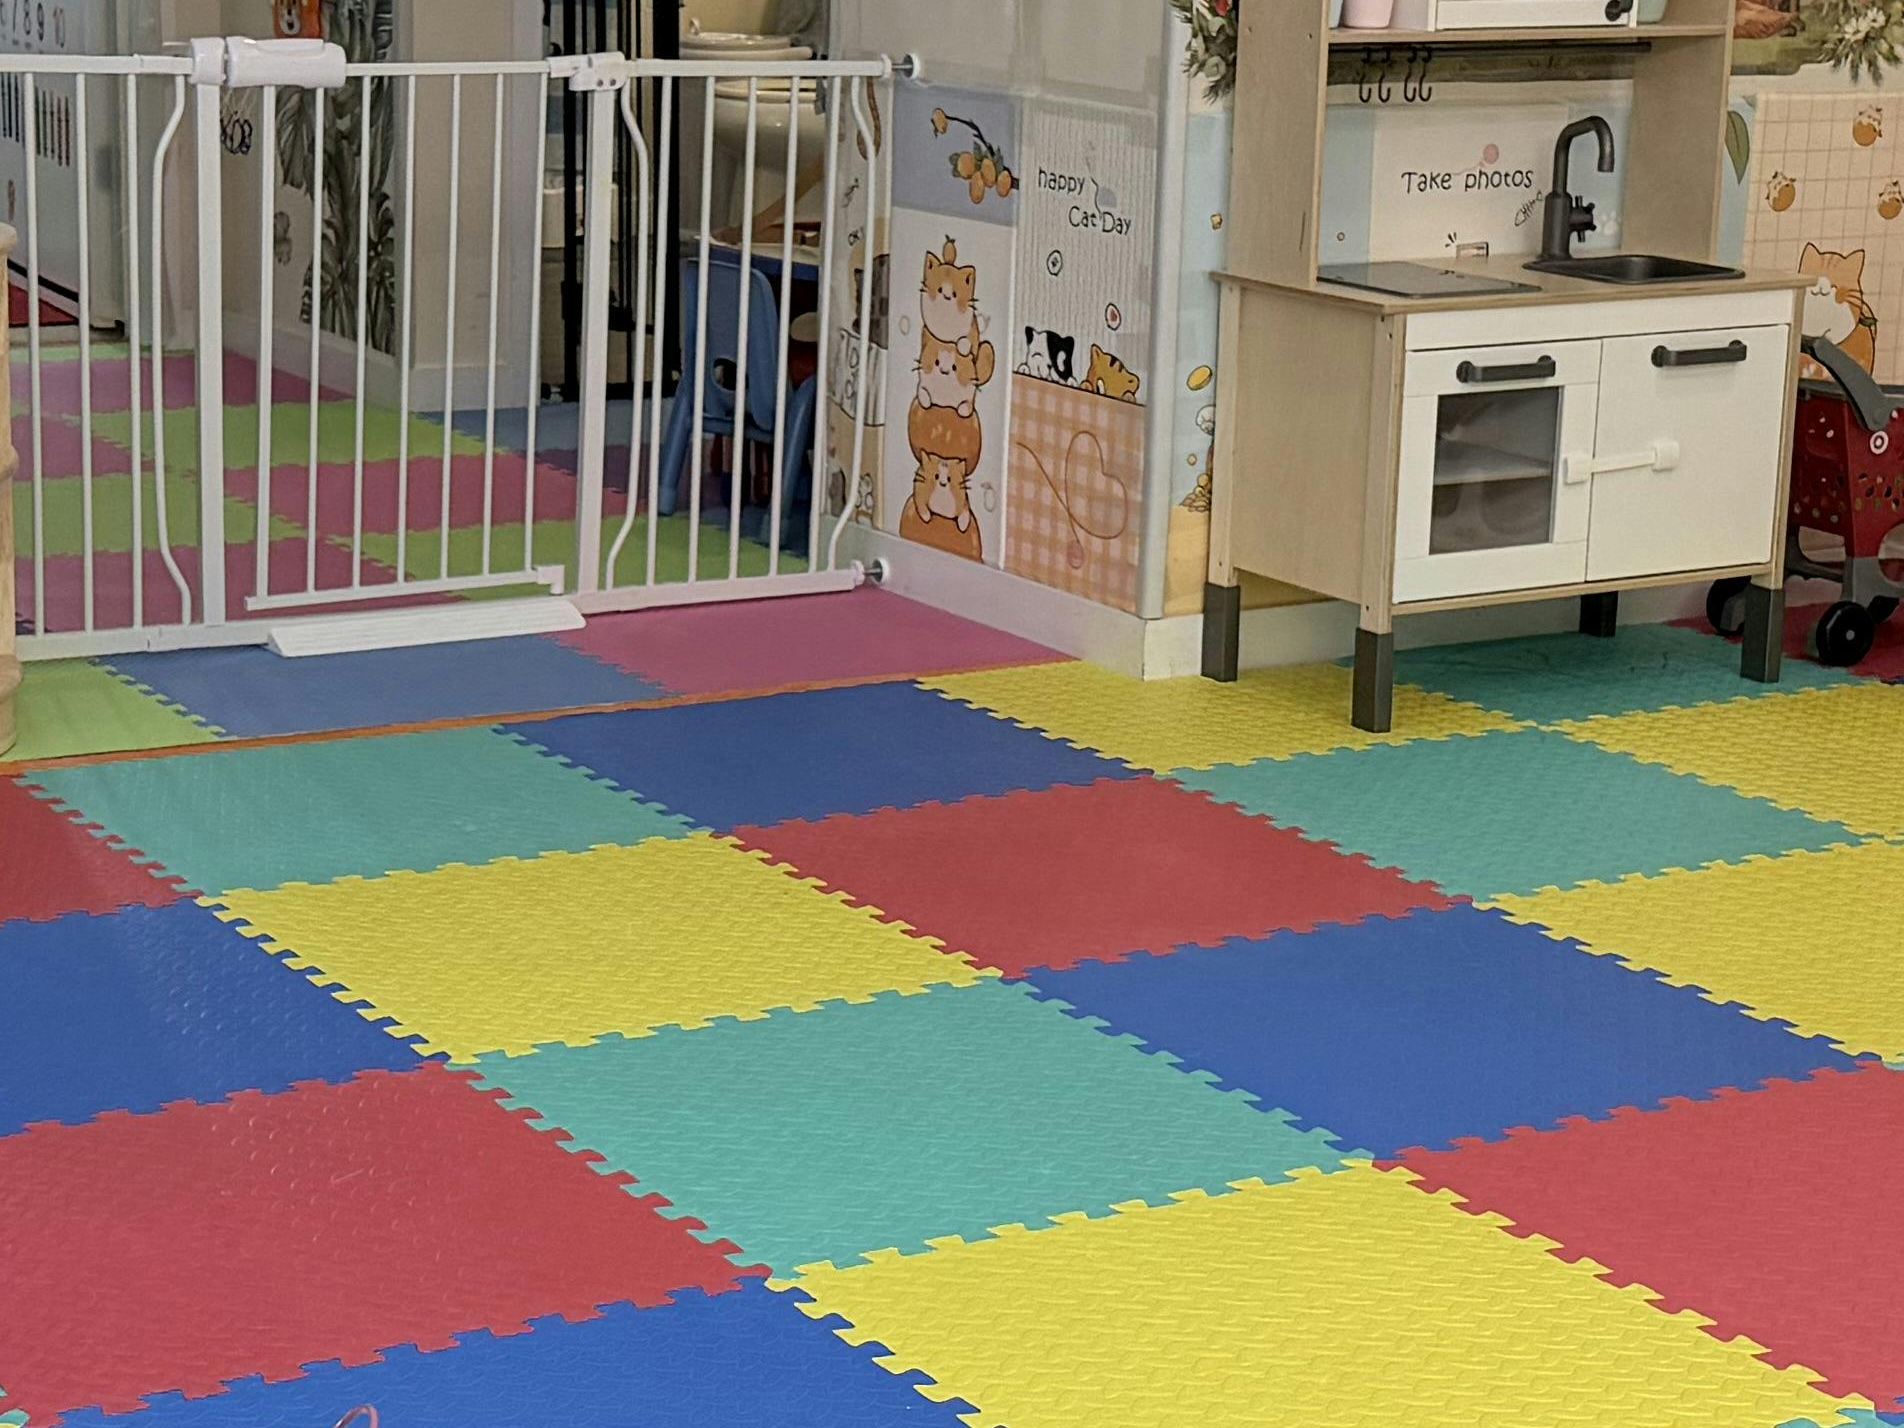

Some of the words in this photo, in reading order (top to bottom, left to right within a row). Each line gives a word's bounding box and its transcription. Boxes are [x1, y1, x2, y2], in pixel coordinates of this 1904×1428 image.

[1401, 171, 1452, 194] Take
[1464, 169, 1534, 192] photos
[1069, 205, 1097, 228] Cat
[1101, 211, 1132, 236] Day
